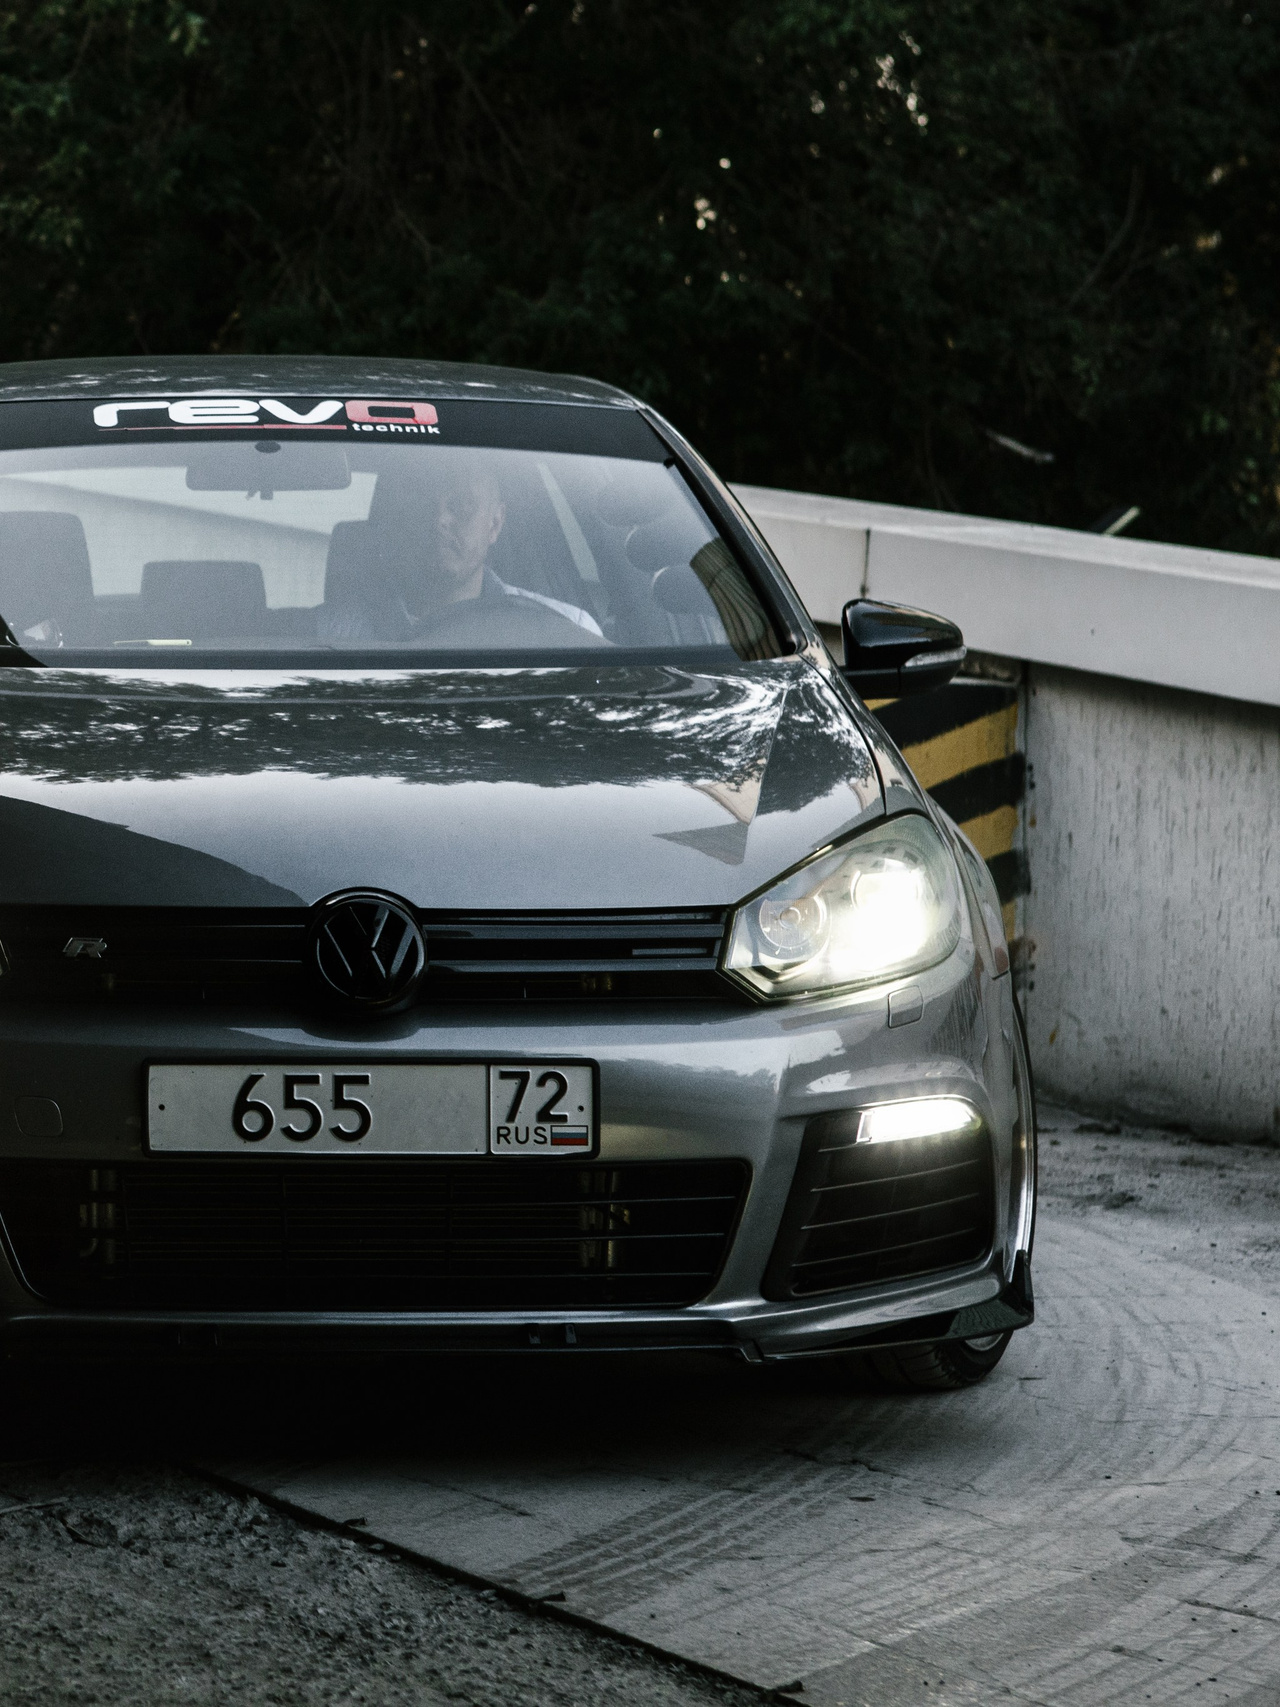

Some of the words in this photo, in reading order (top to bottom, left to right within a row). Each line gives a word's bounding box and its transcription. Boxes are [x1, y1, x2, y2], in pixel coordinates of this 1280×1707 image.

[93, 400, 438, 427] revo
[352, 422, 440, 434] technik
[62, 937, 108, 958] R
[232, 1072, 372, 1142] 655
[498, 1069, 569, 1124] 72
[496, 1126, 549, 1145] RUS
